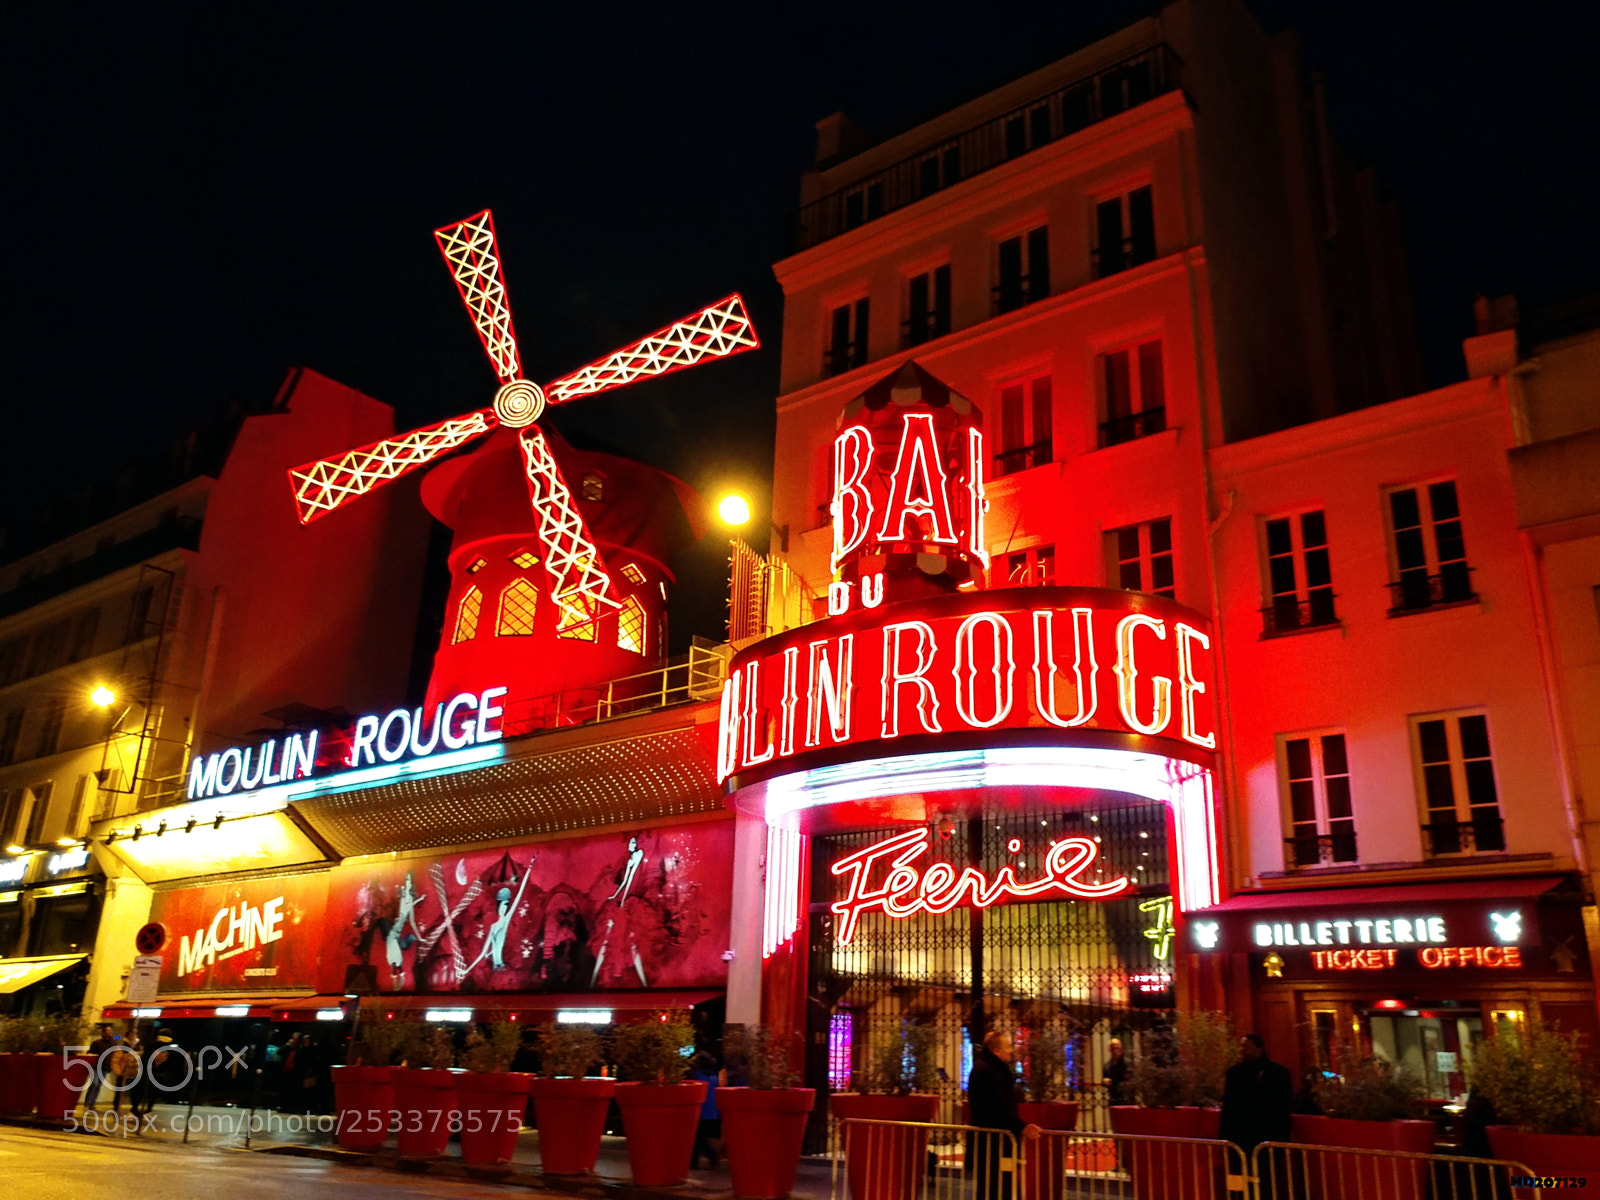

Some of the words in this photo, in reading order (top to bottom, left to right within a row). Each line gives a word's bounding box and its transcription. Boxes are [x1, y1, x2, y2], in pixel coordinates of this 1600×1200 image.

[828, 573, 884, 616] DU
[881, 607, 1216, 749] ROUGE
[187, 729, 319, 800] MOULIN
[351, 686, 507, 767] ROUGE
[831, 827, 1129, 946] Féerie
[177, 896, 284, 977] MACHINE
[1255, 917, 1447, 947] BILLETTERIE
[1312, 949, 1398, 970] TICKET
[1419, 946, 1522, 969] OFFICE
